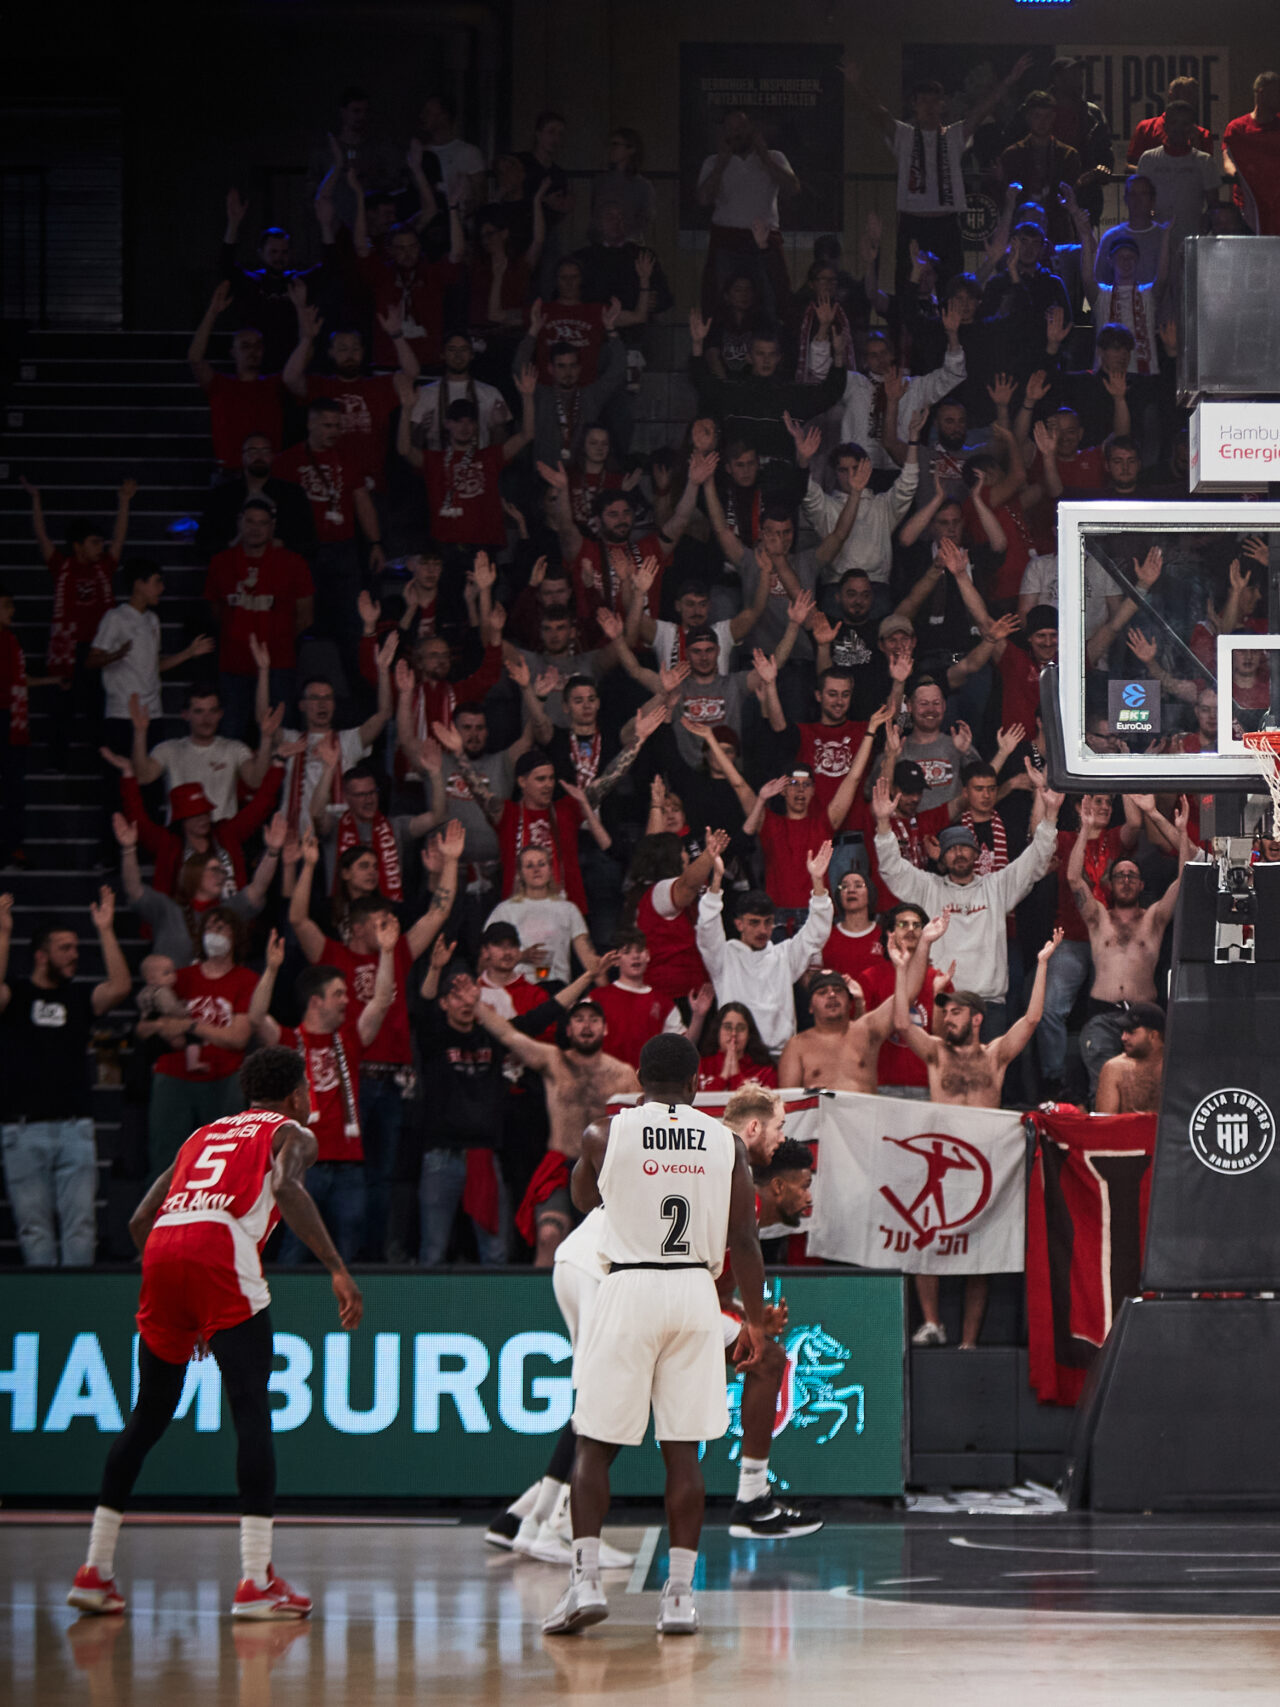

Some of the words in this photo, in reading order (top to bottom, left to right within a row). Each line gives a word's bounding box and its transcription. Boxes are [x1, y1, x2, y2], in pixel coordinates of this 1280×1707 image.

[1116, 722, 1152, 731] EuroCup
[1194, 1093, 1228, 1131] VEOLIA
[1232, 1092, 1271, 1130] TOWERS
[642, 1126, 707, 1151] GOMEZ
[184, 1142, 238, 1190] 5
[662, 1164, 706, 1175] VEOLIA
[1208, 1153, 1258, 1169] HAMBURG
[661, 1194, 690, 1256] 2
